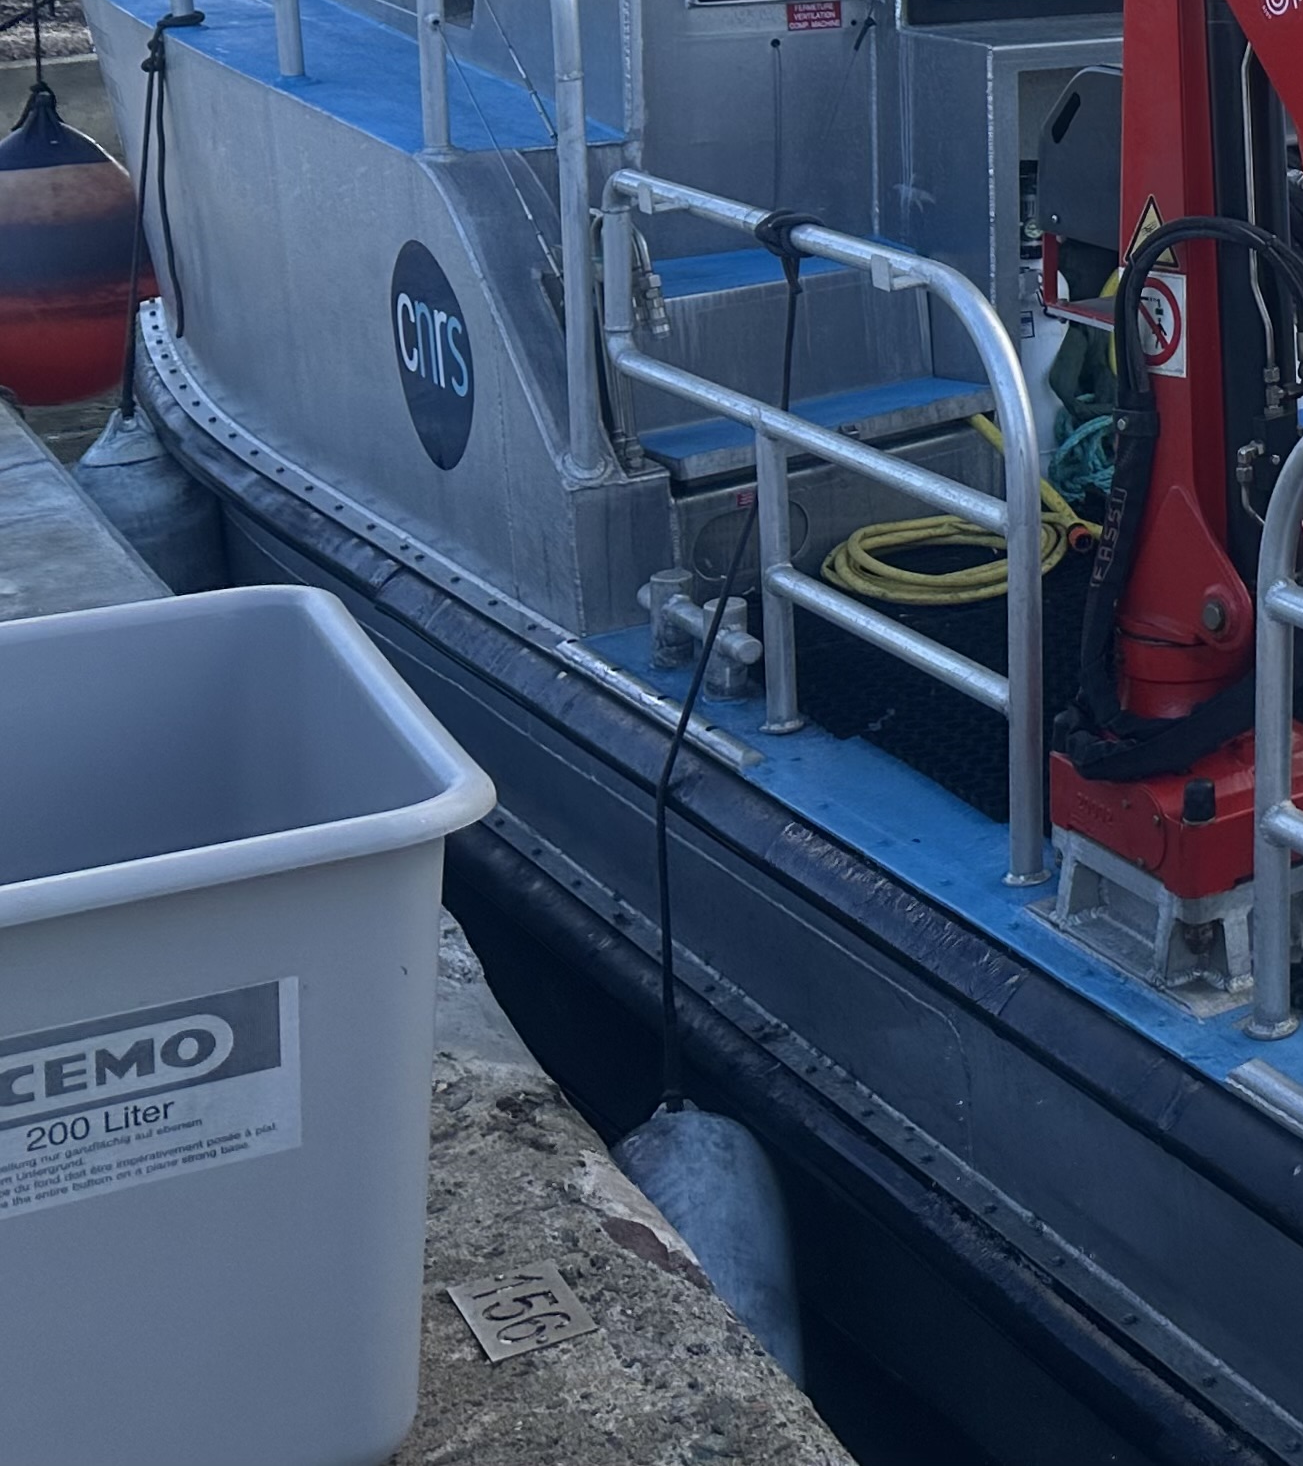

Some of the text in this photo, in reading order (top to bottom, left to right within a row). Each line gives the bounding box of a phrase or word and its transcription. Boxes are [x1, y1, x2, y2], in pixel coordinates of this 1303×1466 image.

[793, 11, 836, 21] VENTILATION
[811, 19, 841, 28] MACHINE
[396, 292, 468, 398] cnrs
[1092, 496, 1125, 582] FASSI
[0, 1028, 217, 1108] CEMO
[26, 1100, 175, 1152] 200 Liter
[472, 1274, 572, 1343] 156
